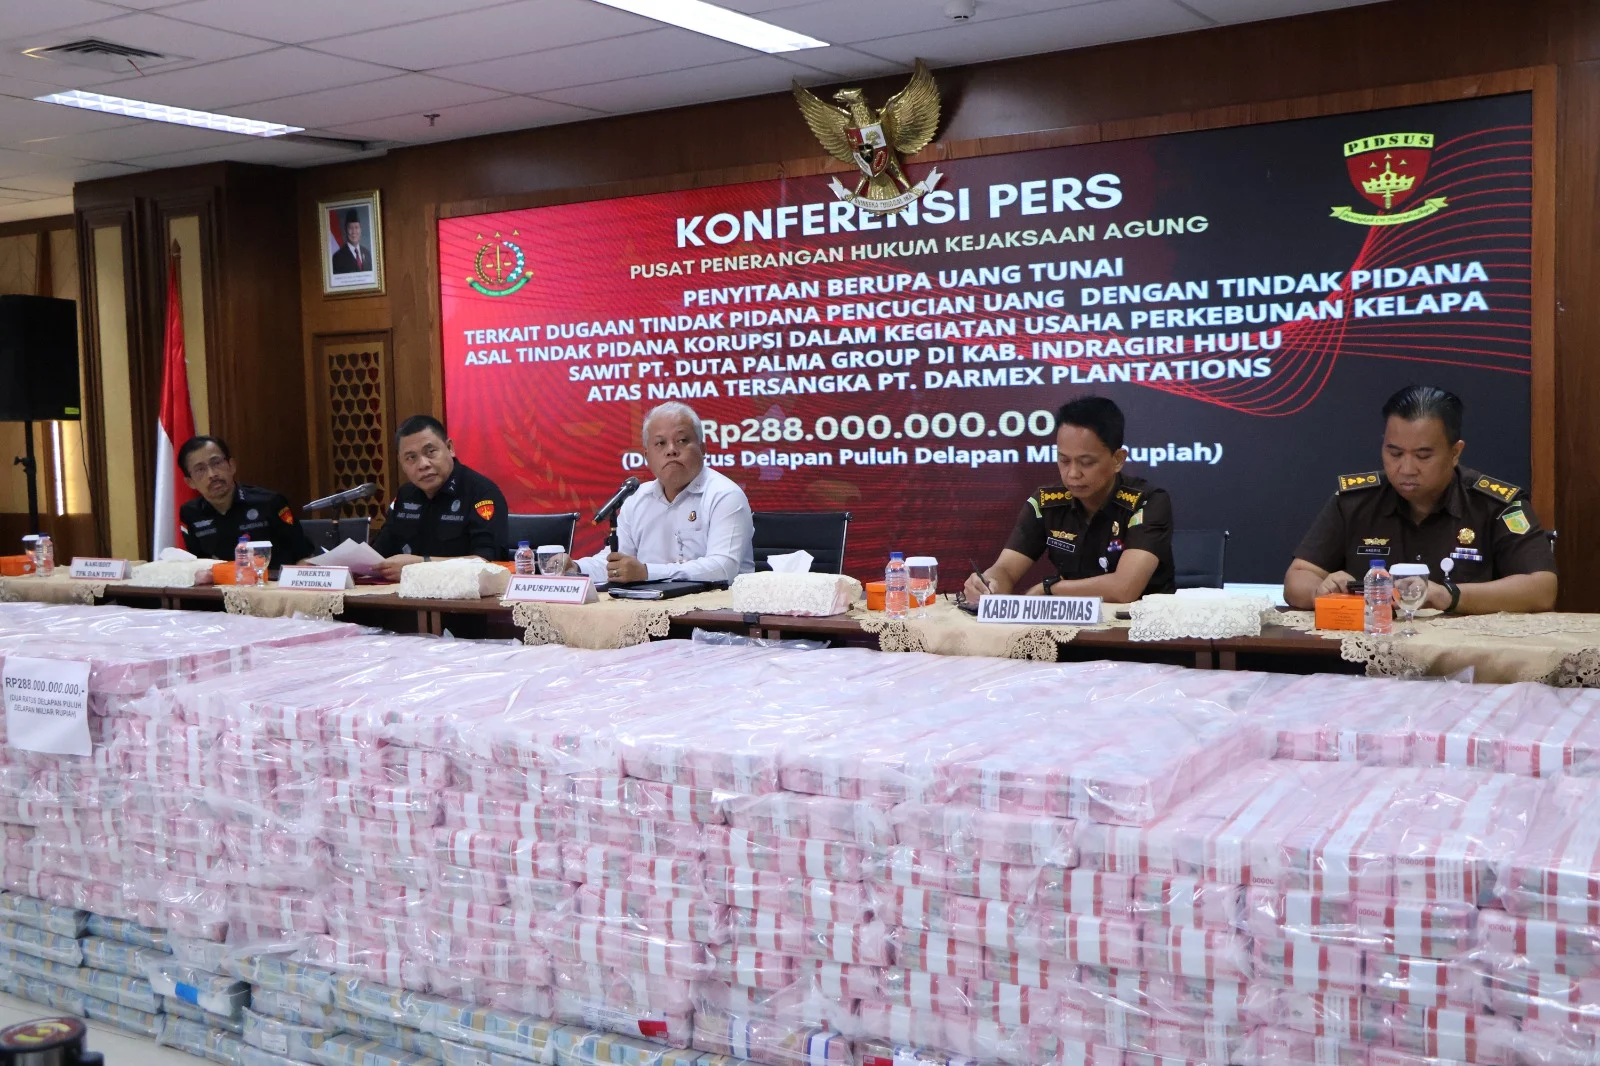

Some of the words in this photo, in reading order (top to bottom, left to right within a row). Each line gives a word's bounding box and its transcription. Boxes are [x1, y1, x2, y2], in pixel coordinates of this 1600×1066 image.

[1348, 134, 1430, 153] PIDSUS
[676, 187, 970, 248] KONFERENSI
[989, 173, 1123, 219] PERS
[629, 259, 696, 280] PUSAT
[700, 246, 844, 275] PENERANGAN
[851, 238, 939, 261] HUKUM
[945, 224, 1095, 253] KEJAKSAAN
[1103, 215, 1209, 240] AGUNG
[464, 325, 542, 346] TERKAIT
[546, 319, 635, 341] DUGAAN
[640, 312, 725, 335] TINDAK
[730, 306, 821, 329] PIDANA
[826, 295, 975, 322] PENCUCIAN
[983, 289, 1065, 313] UANG
[1081, 280, 1209, 307] DENGAN
[1216, 270, 1344, 299] TINDAK
[1351, 261, 1489, 290] PIDANA
[683, 280, 820, 308] PENYITAAN
[827, 272, 932, 296] BERUPA
[938, 264, 1021, 289] UANG
[1028, 257, 1123, 282] TUNAI
[464, 348, 512, 366] ASAL
[515, 342, 592, 363] TINDAK
[597, 337, 679, 358] PIDANA
[683, 332, 783, 353] KORUPSI
[789, 326, 877, 348] DALAM
[884, 318, 1017, 343] KEGIATAN
[1024, 311, 1124, 336] USAHA
[1131, 299, 1343, 330] PERKEBUNAN
[1354, 290, 1489, 318] KELAPA
[568, 362, 634, 382] SAWIT
[638, 360, 671, 379] PT.
[675, 357, 737, 376] DUTA
[743, 352, 825, 374] PALMA
[831, 347, 921, 368] GROUP
[927, 345, 955, 365] DI
[962, 342, 1025, 364] KAB.
[1032, 334, 1184, 360] INDRAGIRI
[1194, 330, 1283, 354] HULU
[586, 384, 642, 403] ATAS
[647, 379, 720, 400] NAMA
[723, 369, 871, 397] TERSANGKA
[877, 371, 917, 391] PT.
[924, 365, 1045, 389] DARMEX
[1051, 357, 1272, 385] PLANTATIONS
[701, 409, 1056, 449] Rp288.000.000.00
[622, 452, 648, 471] (D
[703, 452, 736, 467] tus
[741, 449, 834, 471] Delapan
[839, 446, 908, 466] Puluh
[914, 445, 1019, 468] Delapan
[291, 580, 332, 588] PENYIDIKAN
[514, 583, 580, 594] KAPUSPENKUM
[982, 599, 1020, 619] KABID
[1022, 599, 1093, 621] HUMEDMAS
[37, 697, 62, 707] DELAPAN
[62, 700, 82, 709] PULUH
